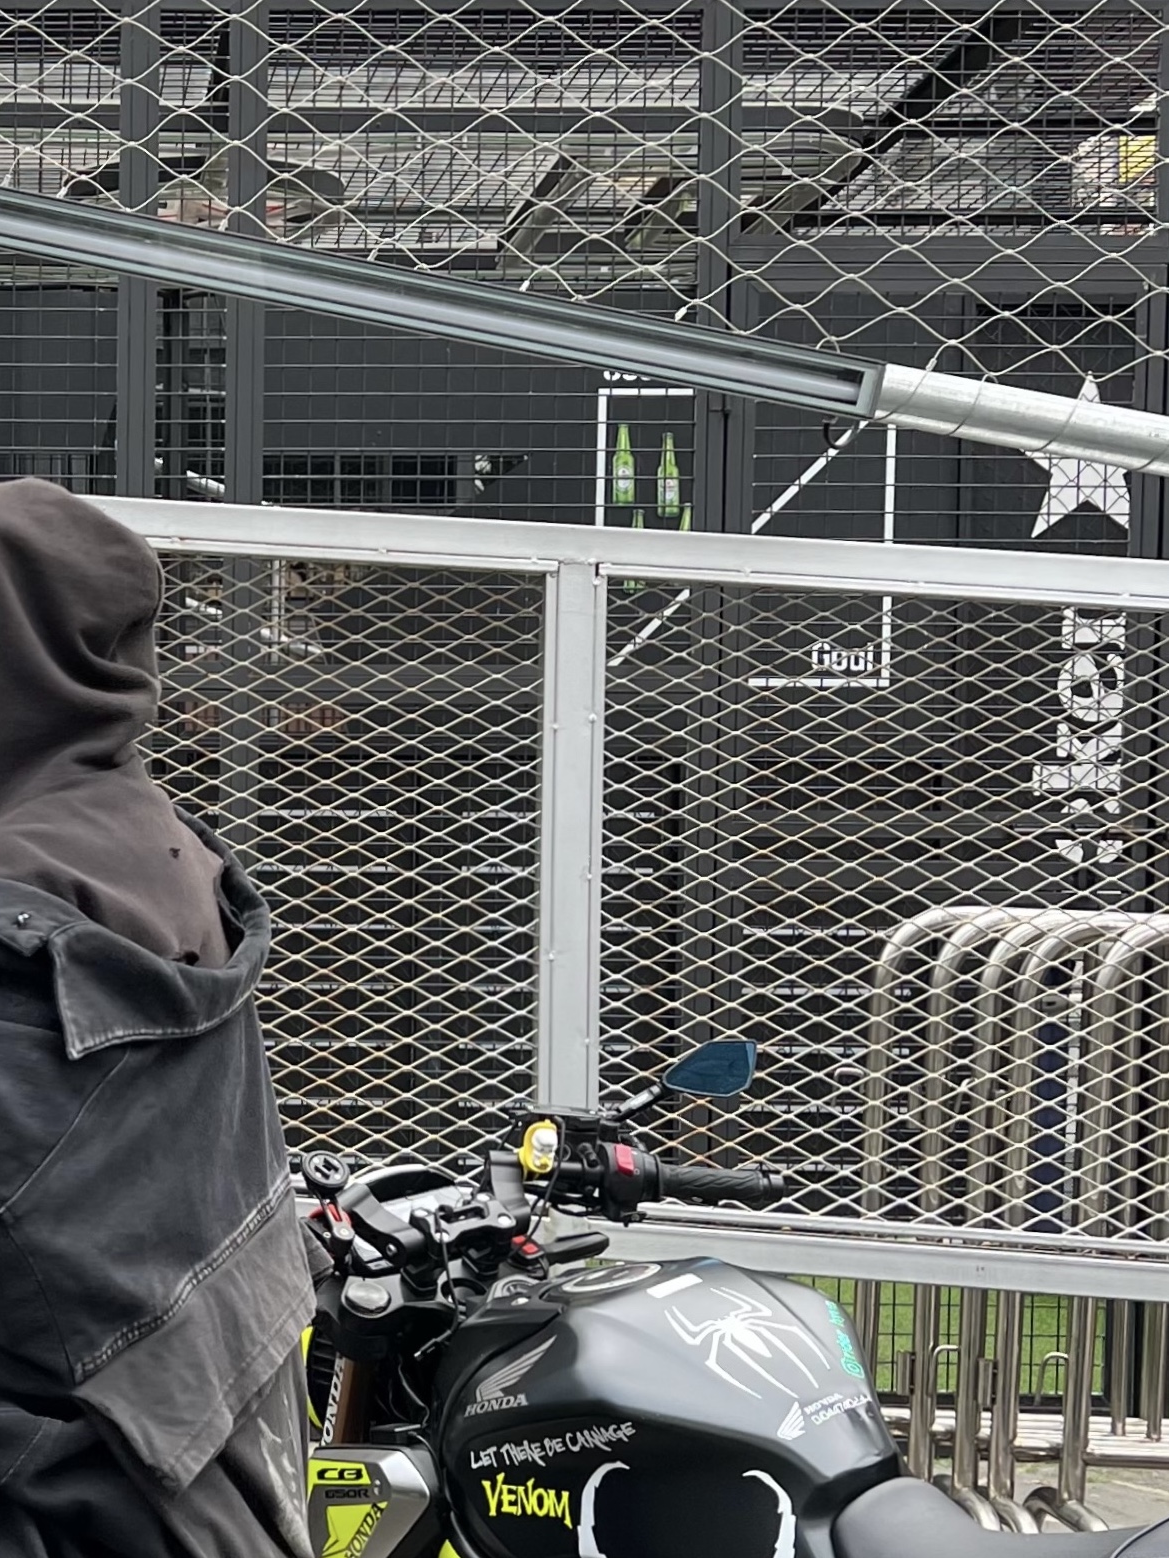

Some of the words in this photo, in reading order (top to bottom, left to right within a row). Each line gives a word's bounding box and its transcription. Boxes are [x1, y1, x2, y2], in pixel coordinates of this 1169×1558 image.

[321, 1352, 346, 1446] ONDA
[464, 1393, 529, 1418] HONDA
[470, 1446, 498, 1469] LET
[500, 1440, 546, 1467] THERE
[544, 1437, 566, 1457] BE
[565, 1421, 636, 1452] CARNAGE
[316, 1468, 364, 1481] CB
[324, 1488, 371, 1499] 650R
[481, 1472, 573, 1529] VENOM
